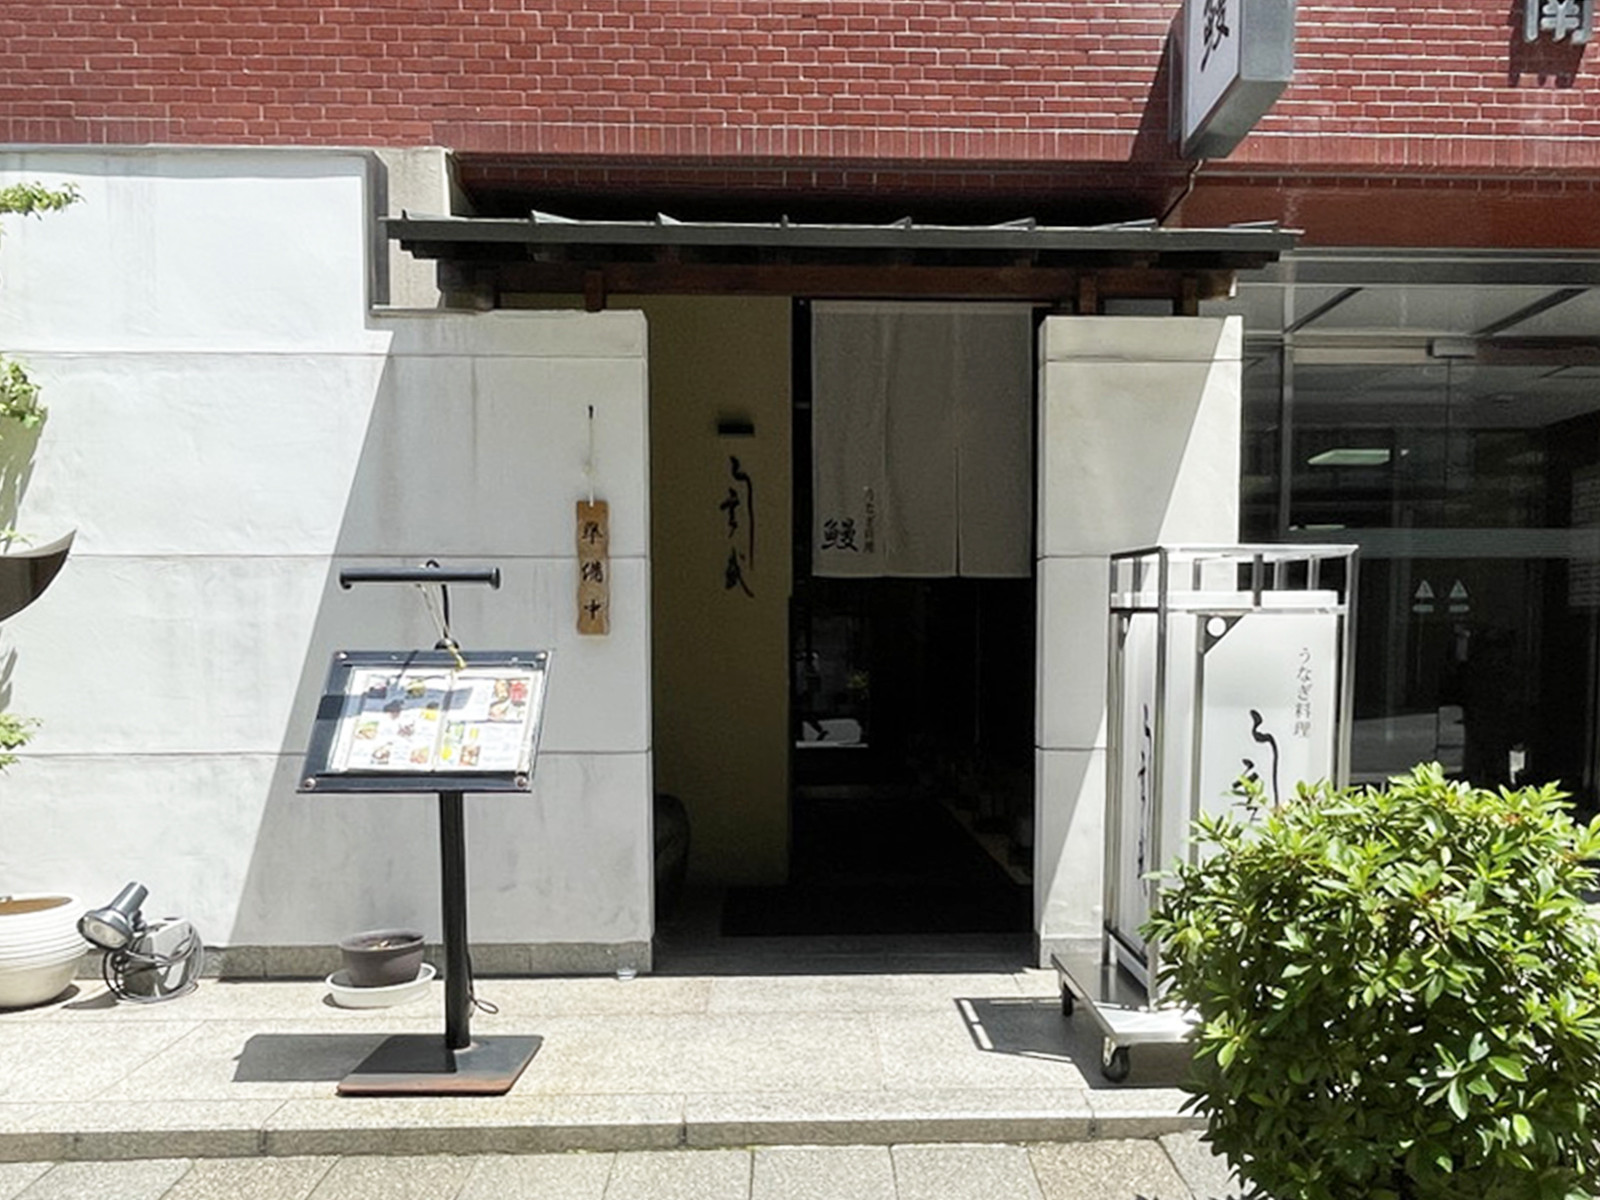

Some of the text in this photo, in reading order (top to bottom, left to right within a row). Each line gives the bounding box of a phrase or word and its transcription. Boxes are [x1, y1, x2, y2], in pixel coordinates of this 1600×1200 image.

[821, 517, 859, 552] 鰻
[1292, 646, 1313, 738] うなぎ料理
